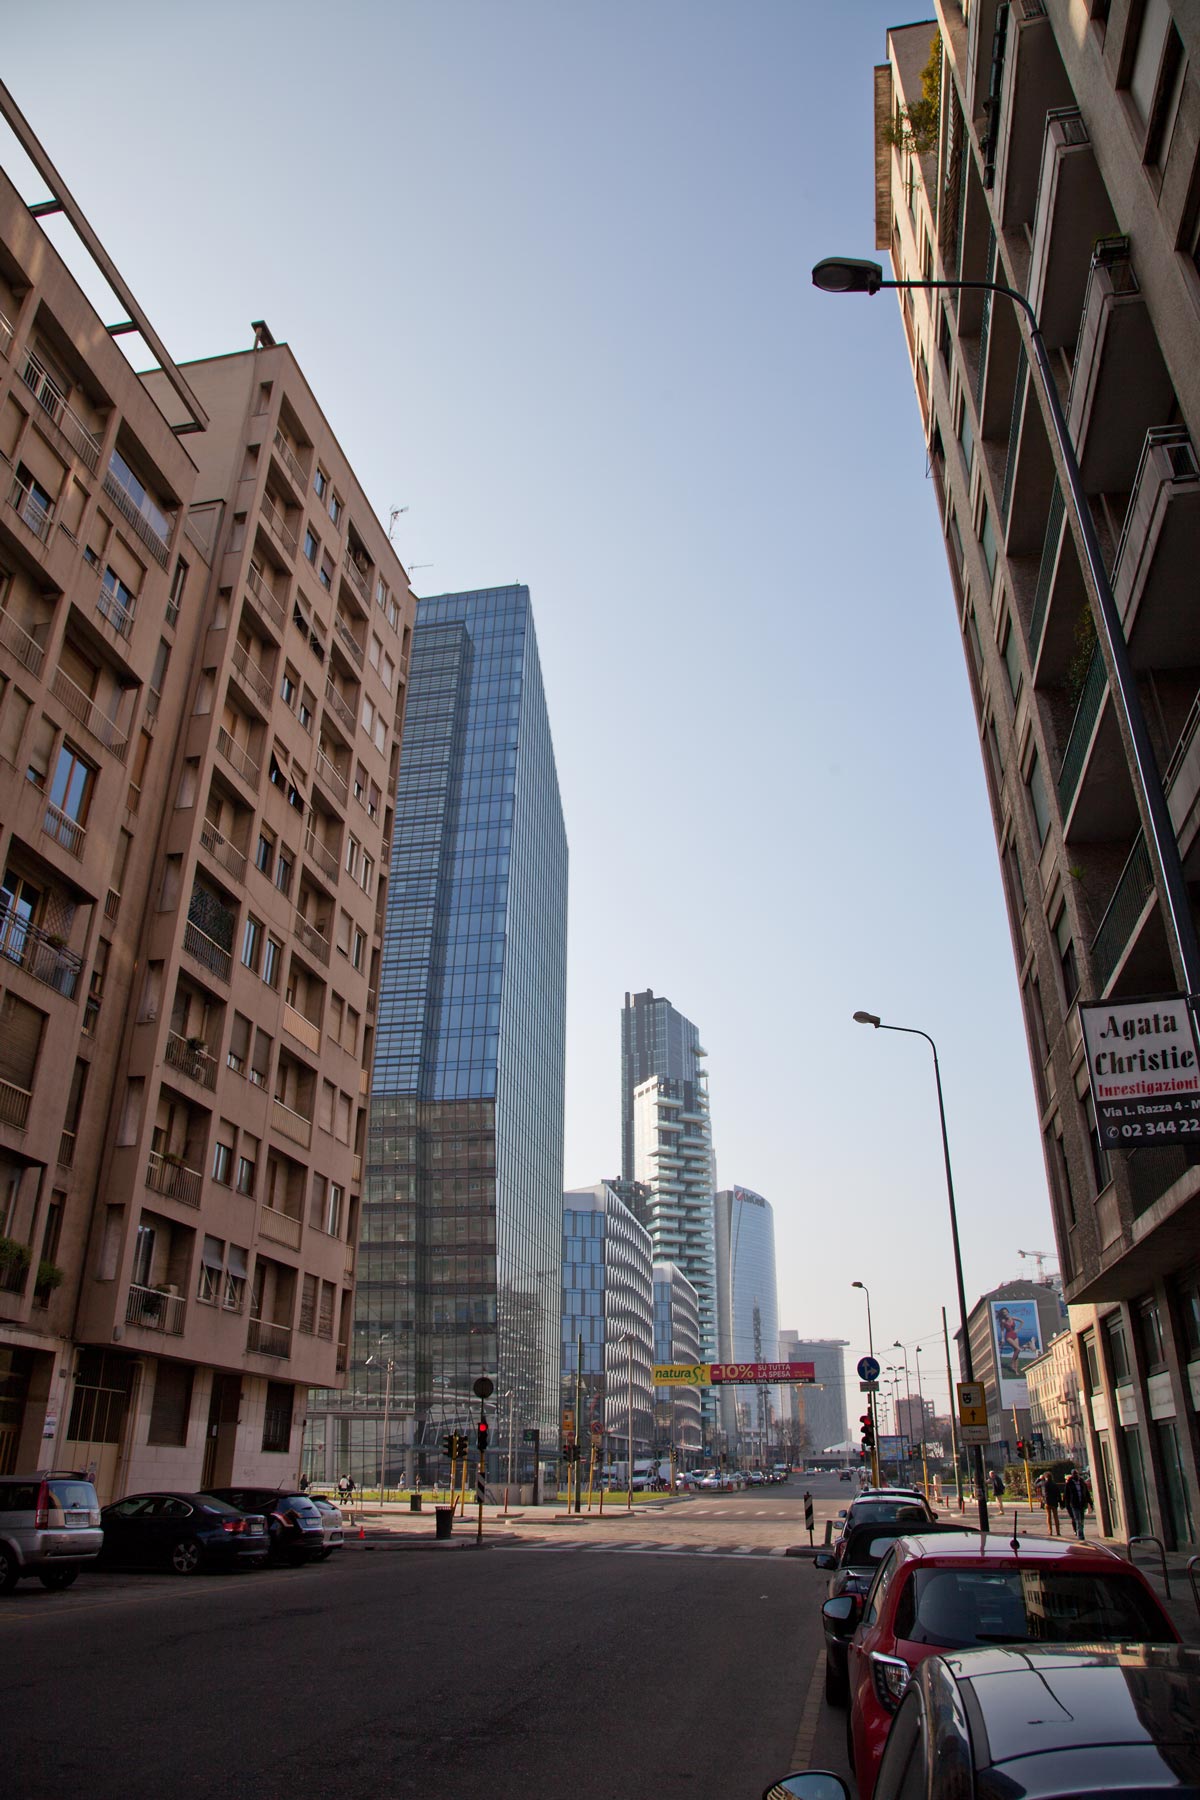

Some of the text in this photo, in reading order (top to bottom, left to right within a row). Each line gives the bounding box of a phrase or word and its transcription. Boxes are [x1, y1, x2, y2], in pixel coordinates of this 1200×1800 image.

[1100, 1014, 1178, 1040] Agata
[1095, 1046, 1194, 1076] Christie
[1098, 1076, 1198, 1097] Investigazioni
[1102, 1107, 1122, 1118] Via
[1124, 1106, 1135, 1116] L.
[1137, 1102, 1172, 1114] Razza
[1174, 1101, 1182, 1110] 4
[1122, 1124, 1142, 1137] 02
[1146, 1121, 1176, 1136] 344
[713, 1364, 754, 1378] -10%
